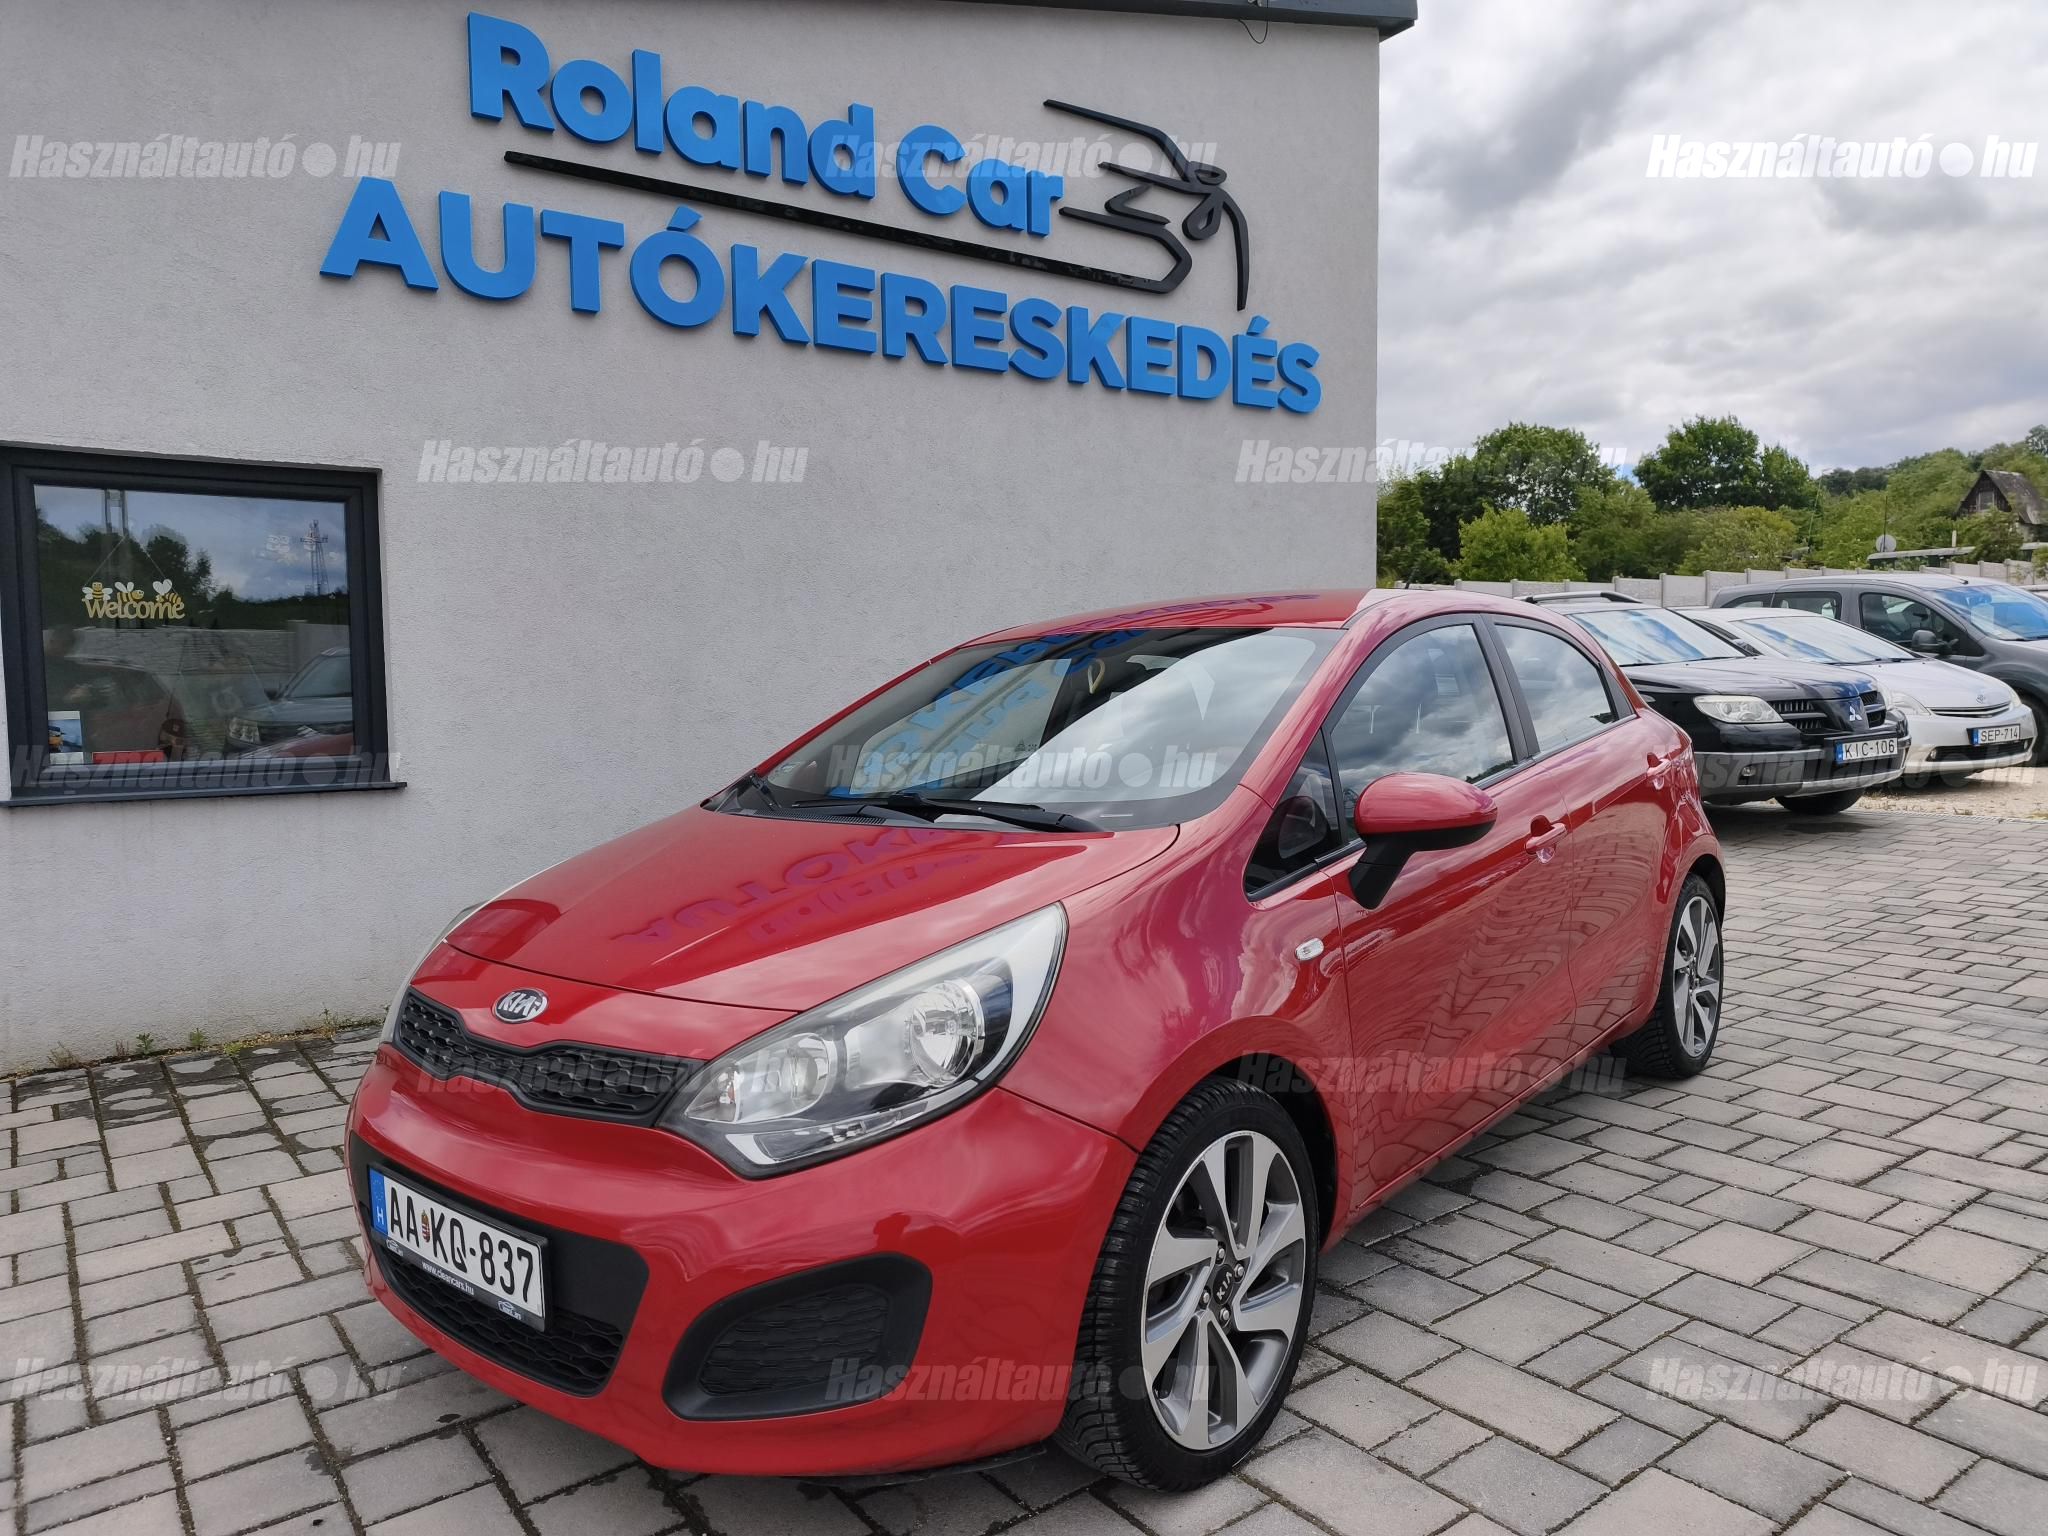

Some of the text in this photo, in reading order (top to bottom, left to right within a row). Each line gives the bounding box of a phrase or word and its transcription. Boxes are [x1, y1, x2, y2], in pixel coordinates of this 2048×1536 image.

[468, 12, 1064, 237] Roland Car
[319, 176, 1322, 415] AUTÓKERESKEDÉS
[82, 597, 185, 619] Welcome
[1980, 727, 2018, 743] SEP-714
[1844, 738, 1896, 760] KIC-106
